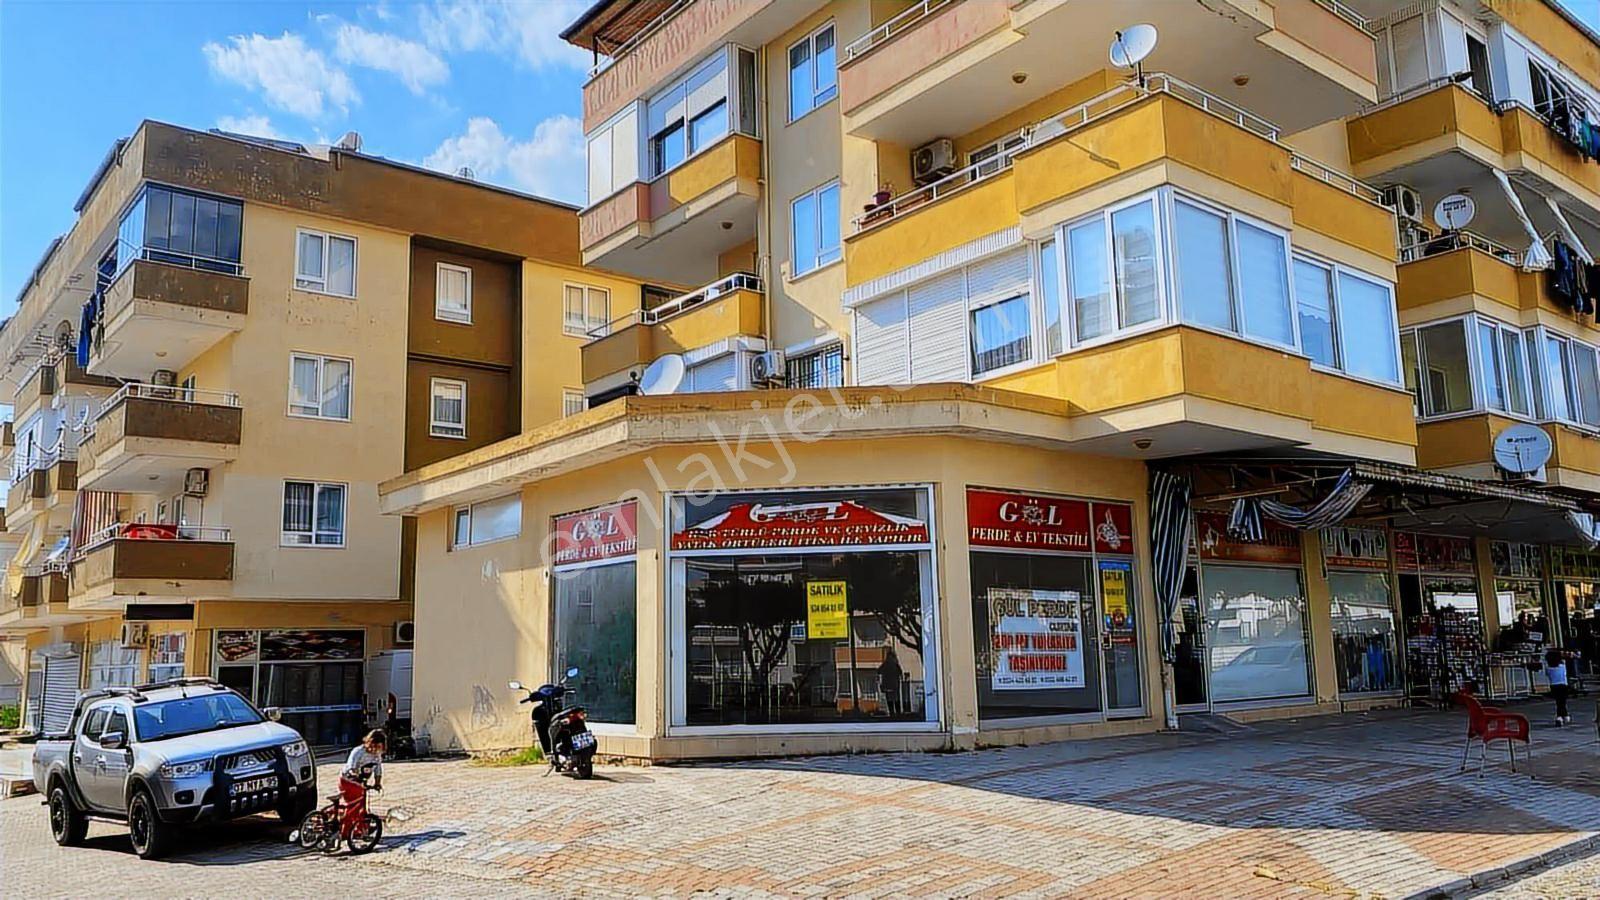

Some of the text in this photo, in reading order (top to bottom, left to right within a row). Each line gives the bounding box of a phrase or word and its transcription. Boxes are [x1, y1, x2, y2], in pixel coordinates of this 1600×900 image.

[972, 527, 1011, 542] PERDE
[1014, 532, 1023, 543] &
[1043, 531, 1089, 546] TEKSTİLİ
[810, 585, 844, 596] SATILIK
